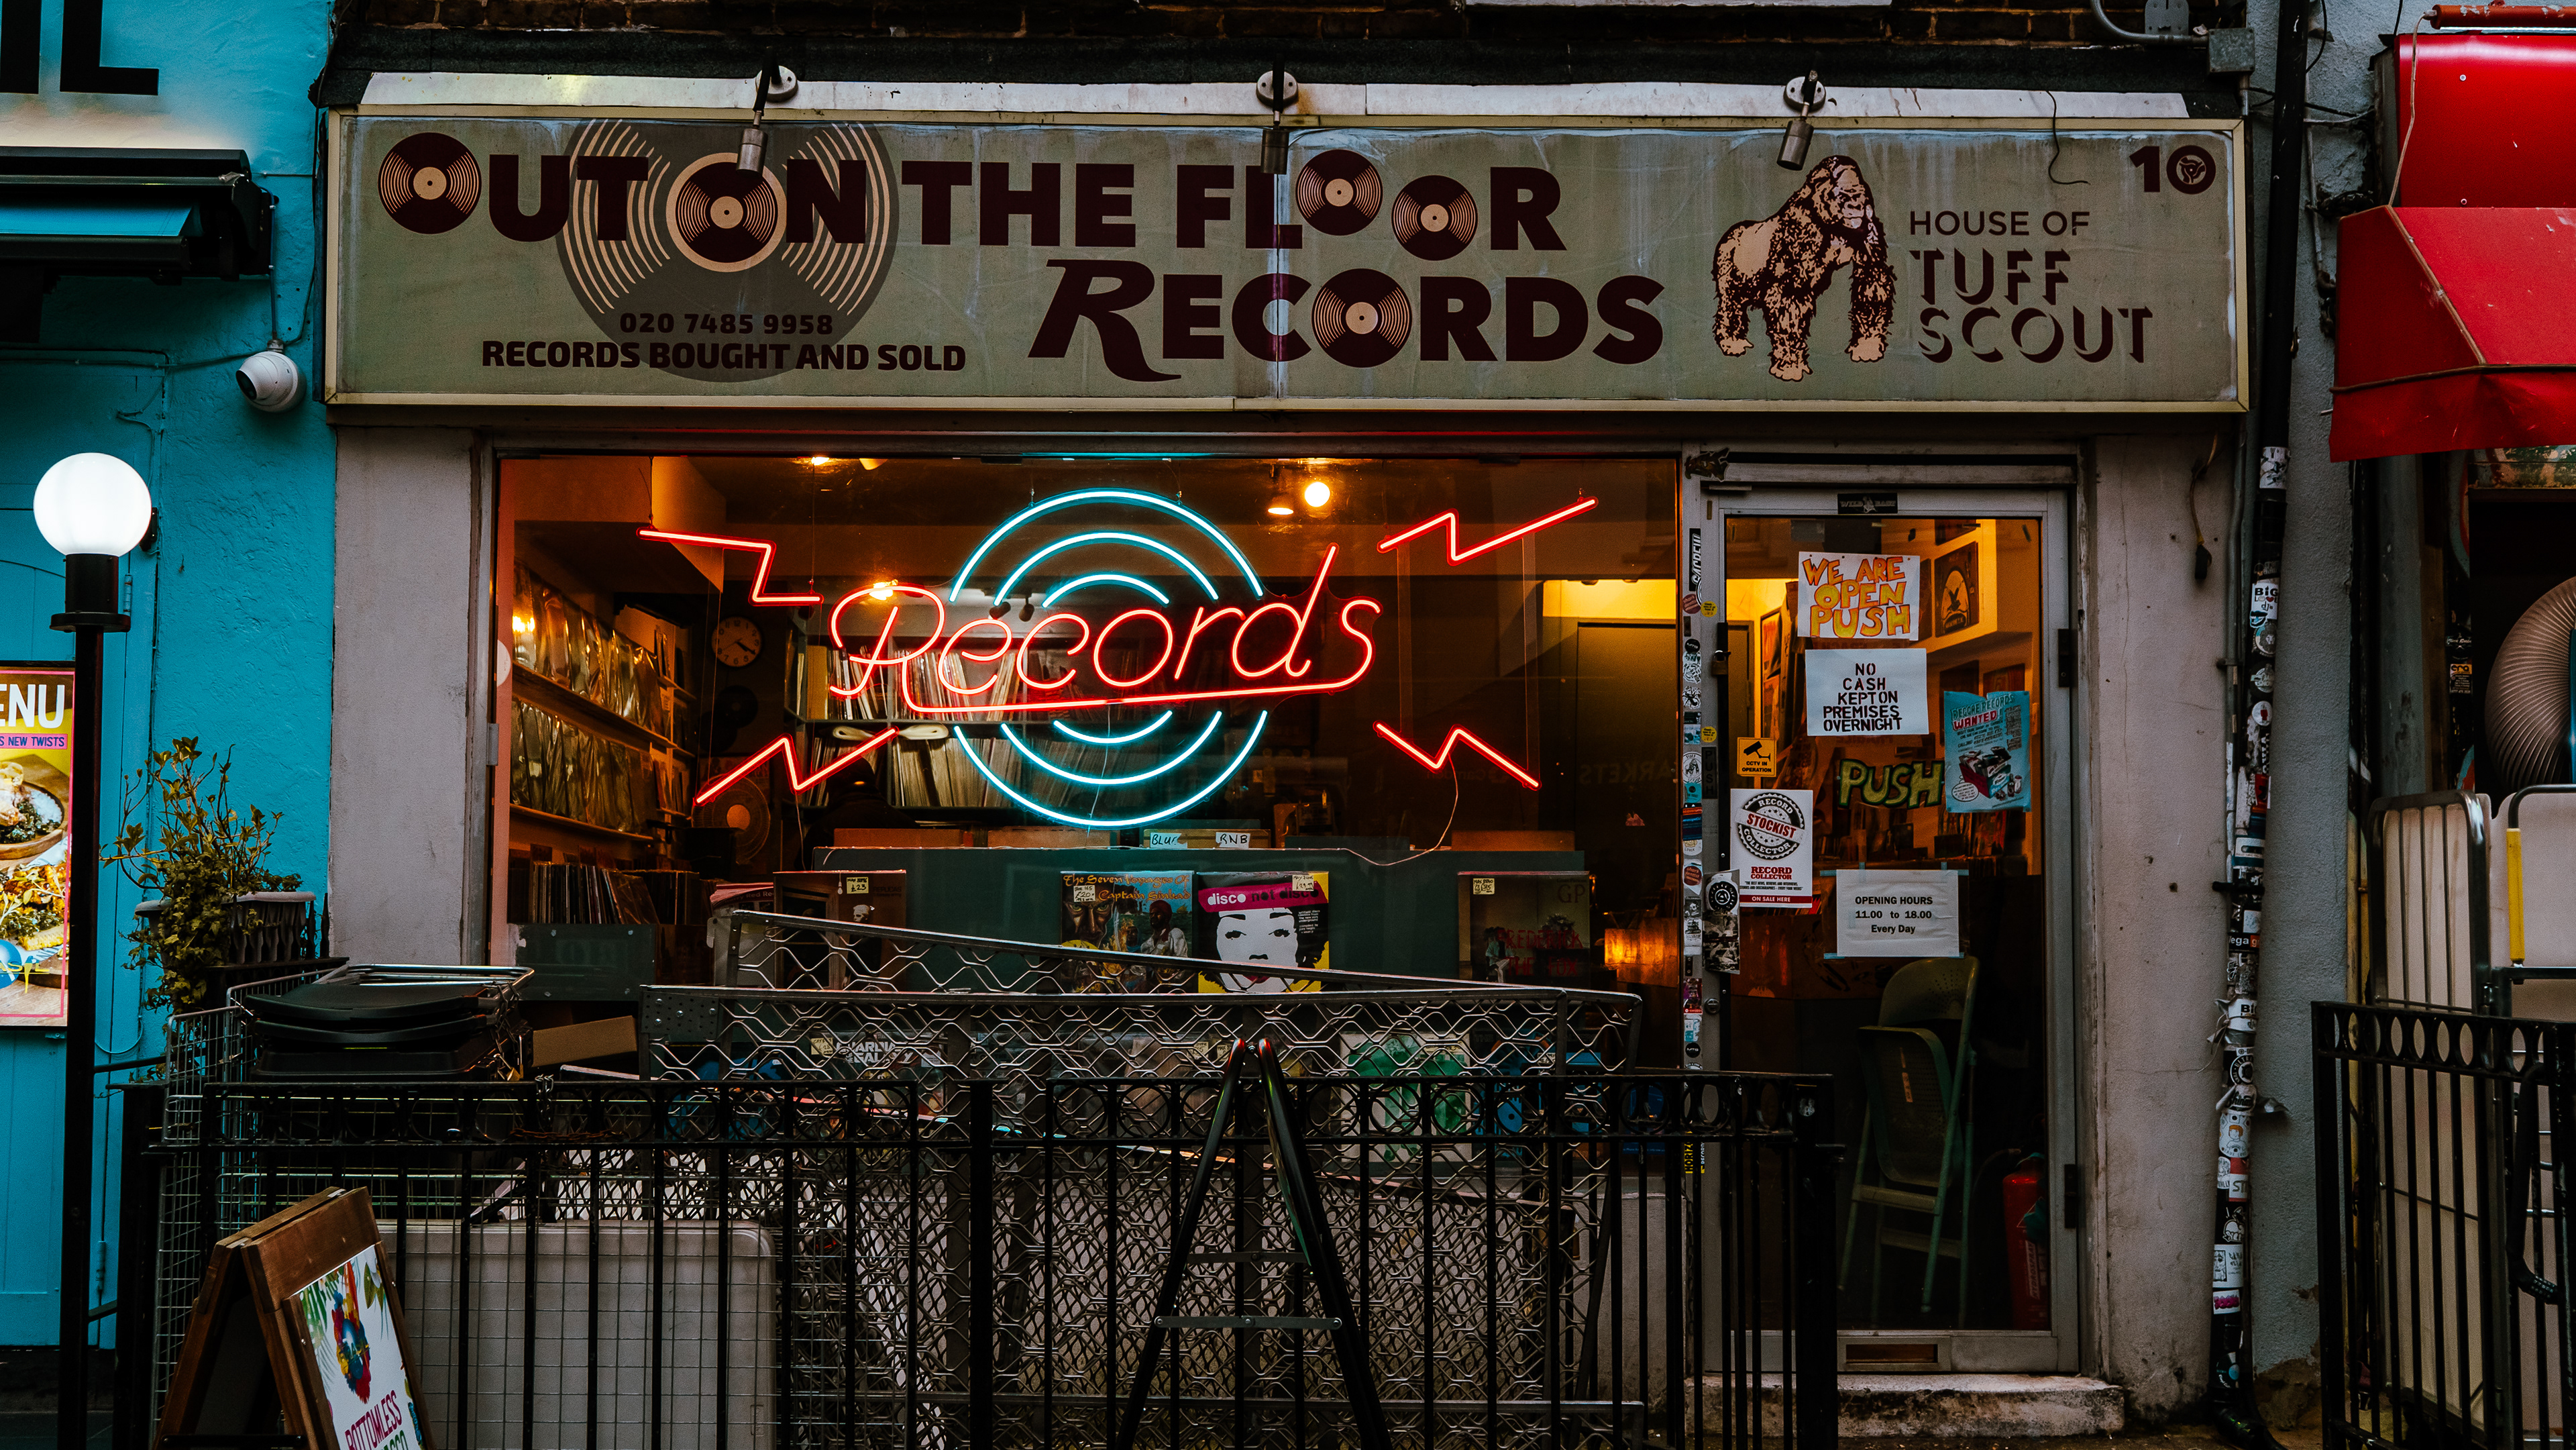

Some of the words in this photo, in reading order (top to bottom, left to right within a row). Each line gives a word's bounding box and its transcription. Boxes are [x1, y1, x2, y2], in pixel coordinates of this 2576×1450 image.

[2129, 145, 2216, 195] 10
[378, 132, 649, 242] OUT
[674, 160, 867, 264] ON
[901, 160, 1136, 248] THE
[1176, 149, 1567, 261] FLOOR
[1911, 210, 2030, 236] HOUSE
[2043, 210, 2090, 236] OF
[1911, 247, 2071, 305] TUFF
[620, 312, 674, 334] 020
[684, 313, 755, 335] 7485
[763, 314, 833, 335] 9958
[1028, 259, 1665, 382] RECORDS
[1917, 305, 2153, 364] SCOUT
[482, 340, 641, 368] RECORDS
[649, 342, 792, 370] BOUGHT
[796, 343, 870, 371] AND
[877, 344, 966, 372] SOLD
[1803, 558, 1843, 586] WE
[1856, 556, 1905, 583] ARE
[1814, 579, 1907, 610] OPEN
[828, 542, 1383, 714] Records
[1810, 605, 1911, 638] PUSH
[1856, 663, 1876, 676] NO
[1843, 678, 1886, 690] CASH
[1838, 692, 1876, 705] KEPT
[1878, 690, 1898, 704] ON
[1982, 694, 2015, 712] RECORDS
[1823, 705, 1900, 719] PREMISES
[1823, 717, 1902, 732] OVERNIGHT
[8, 737, 28, 746] NEW
[31, 737, 65, 747] TWISTS
[1839, 758, 1945, 809] PUSH
[1758, 798, 1793, 814] RECORD
[1747, 813, 1796, 839] STOCKIST
[1220, 833, 1248, 844] RNB
[1744, 829, 1790, 854] COLLECTOR
[1751, 866, 1792, 874] RECORD
[1063, 874, 1083, 886] The
[1085, 874, 1122, 885] Seven
[1124, 873, 1173, 888] Voyages
[1175, 874, 1191, 888] Of
[1098, 890, 1144, 901] Captain
[1146, 888, 1191, 902] Sinbad
[1208, 893, 1246, 905] disco
[1251, 890, 1275, 902] not
[1279, 886, 1319, 899] disco
[1558, 884, 1585, 902] GP
[1855, 896, 1897, 904] OPENING
[1900, 896, 1933, 904] HOURS
[1856, 911, 1882, 919] 11.00
[1890, 911, 1899, 919] to
[1905, 911, 1932, 919] 18.00
[1497, 929, 1583, 949] FREDERICK
[1871, 925, 1896, 934] Every
[1898, 925, 1916, 934] Day
[1503, 957, 1535, 976] THE
[1548, 957, 1578, 976] FOX
[1684, 1141, 1693, 1173] HORIZ
[345, 1390, 402, 1450] BOTTOMLESS
